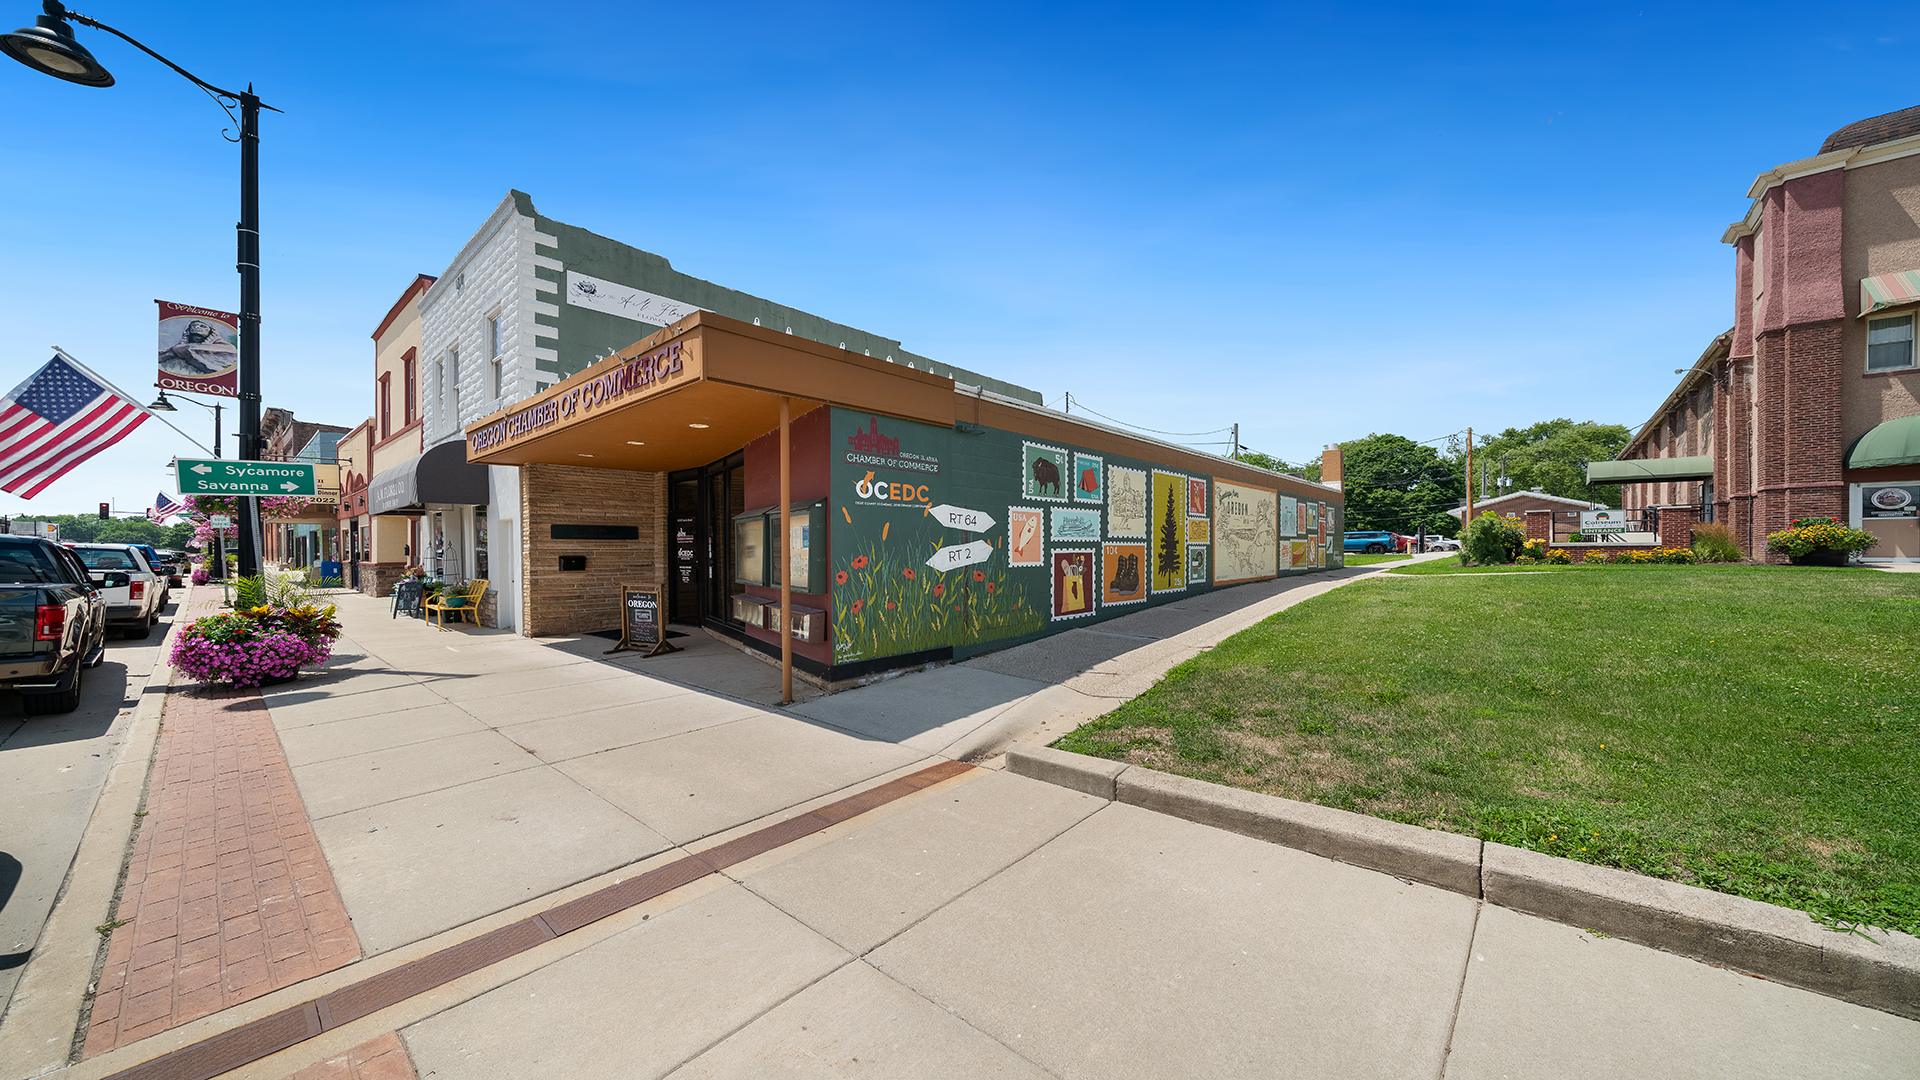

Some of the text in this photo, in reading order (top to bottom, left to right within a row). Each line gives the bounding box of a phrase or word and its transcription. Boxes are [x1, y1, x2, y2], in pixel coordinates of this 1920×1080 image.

[166, 302, 218, 317] Welcome
[160, 378, 235, 396] OREGON
[471, 340, 684, 452] OREGON CHAMBER OF COMMERCE
[846, 453, 939, 472] CHAMBER OF COMMERCE
[225, 465, 305, 478] Sycamore
[197, 480, 269, 491] Savanna
[855, 477, 930, 503] OCEDC
[949, 513, 977, 526] RT 64
[1013, 513, 1027, 522] USA
[948, 548, 972, 562] RT 2
[627, 599, 658, 609] OREGON
